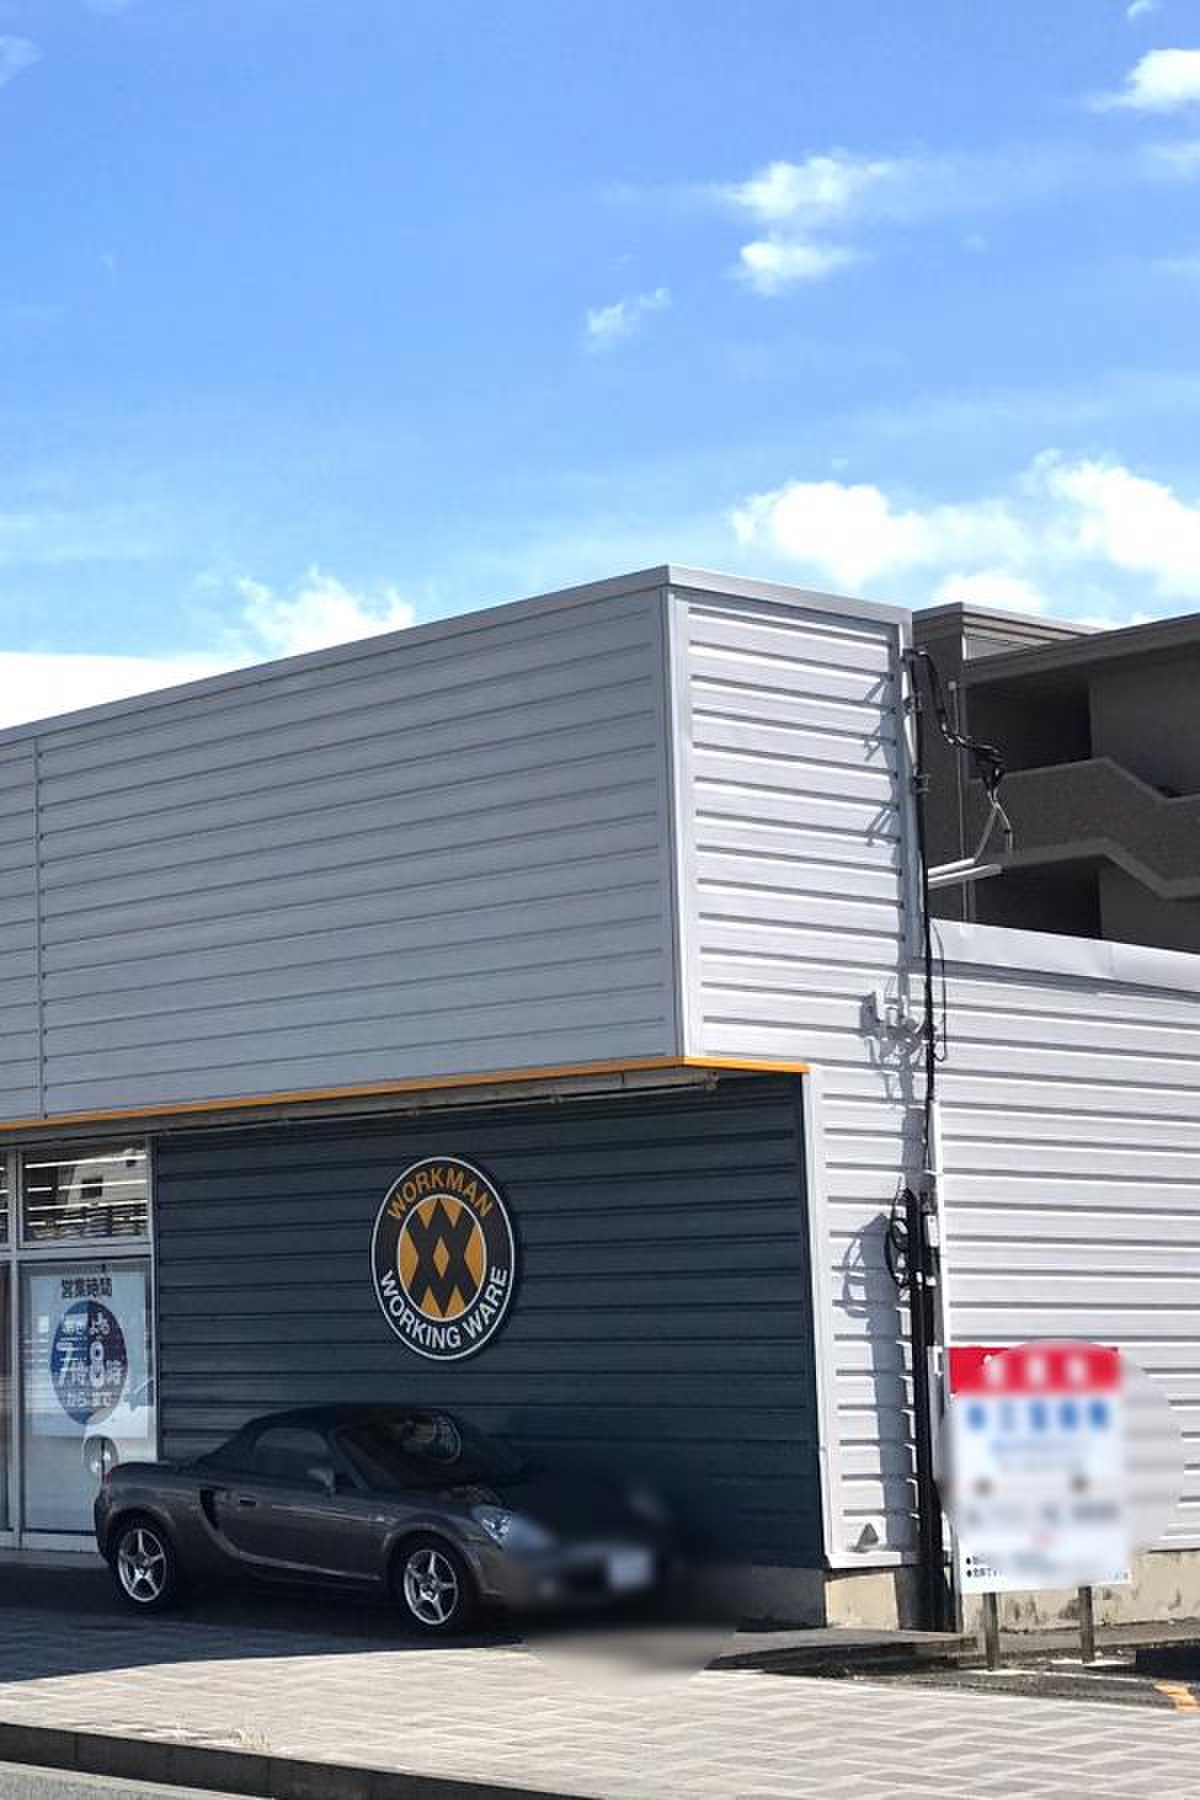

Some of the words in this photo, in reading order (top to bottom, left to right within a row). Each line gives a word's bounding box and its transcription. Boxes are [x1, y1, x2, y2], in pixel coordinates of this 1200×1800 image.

[387, 1167, 493, 1220] WORKMAN
[61, 1278, 113, 1298] 営業時間
[381, 1269, 461, 1349] WORKING
[462, 1266, 508, 1340] WARE
